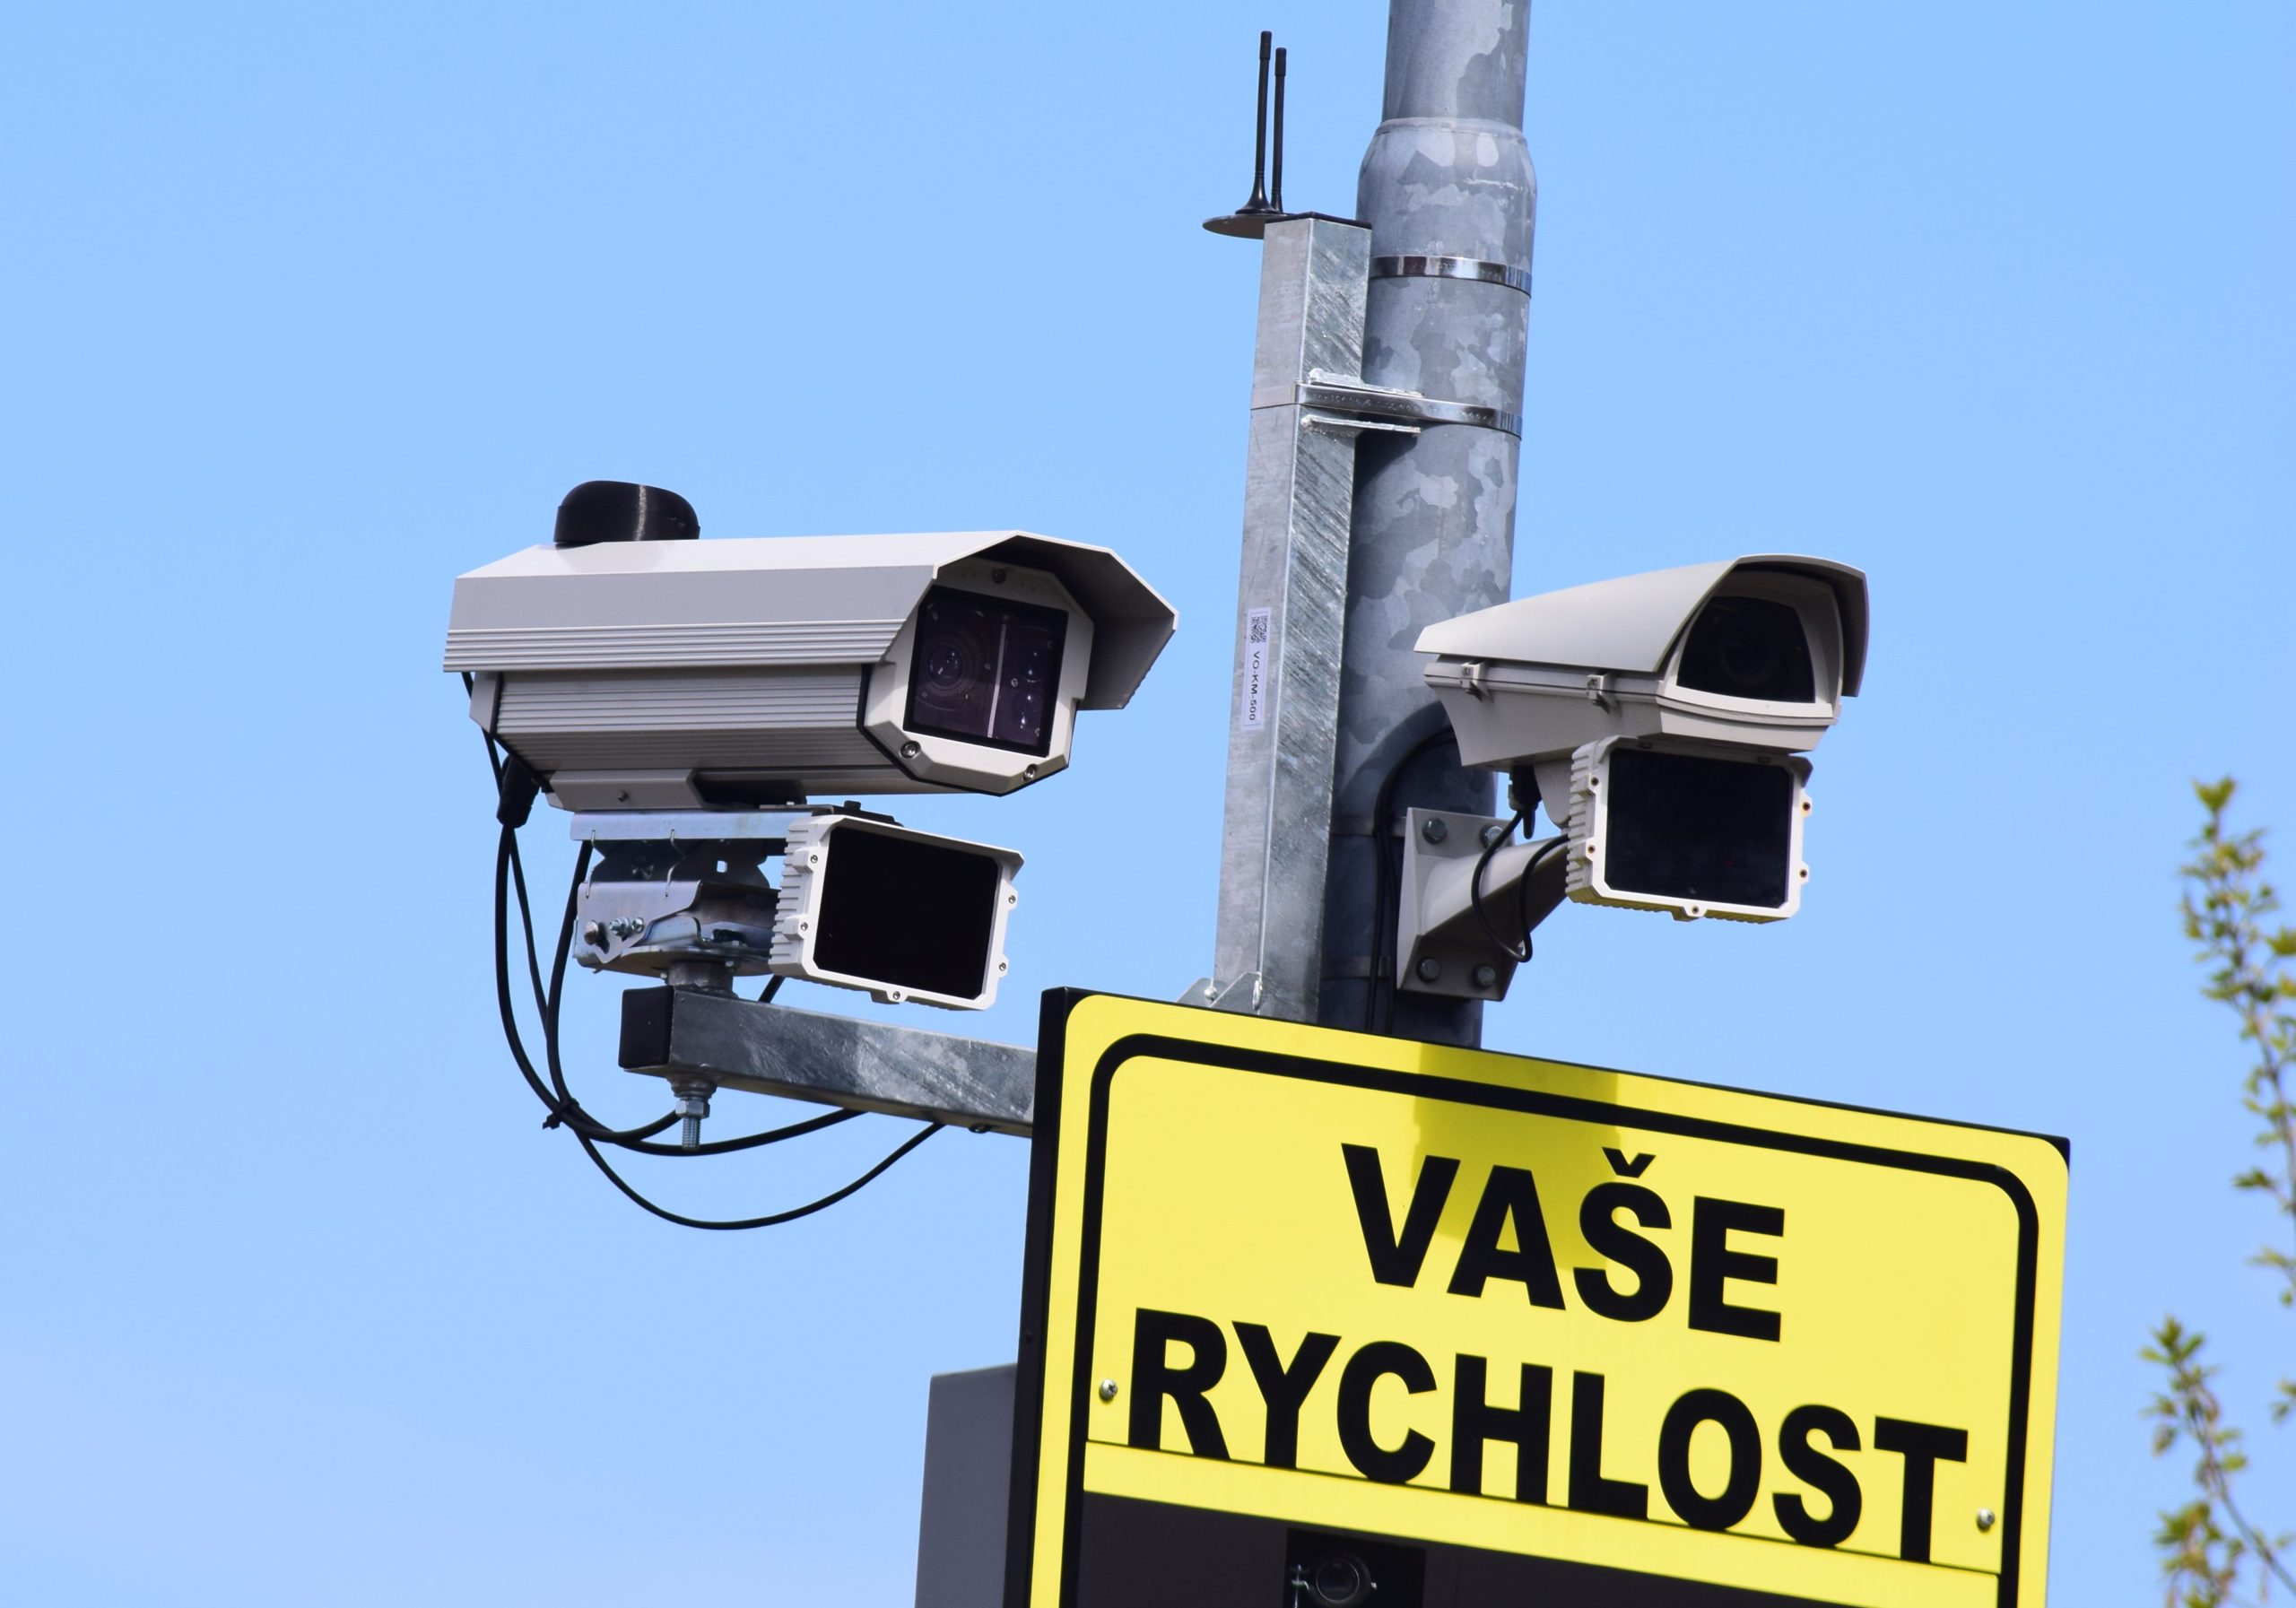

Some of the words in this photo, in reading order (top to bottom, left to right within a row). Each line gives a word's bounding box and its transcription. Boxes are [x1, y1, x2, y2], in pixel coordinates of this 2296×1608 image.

[1248, 650, 1260, 721] VO-KM-500
[1342, 1143, 1785, 1342] VAŠE
[1127, 1307, 1968, 1563] RYCHLOST
